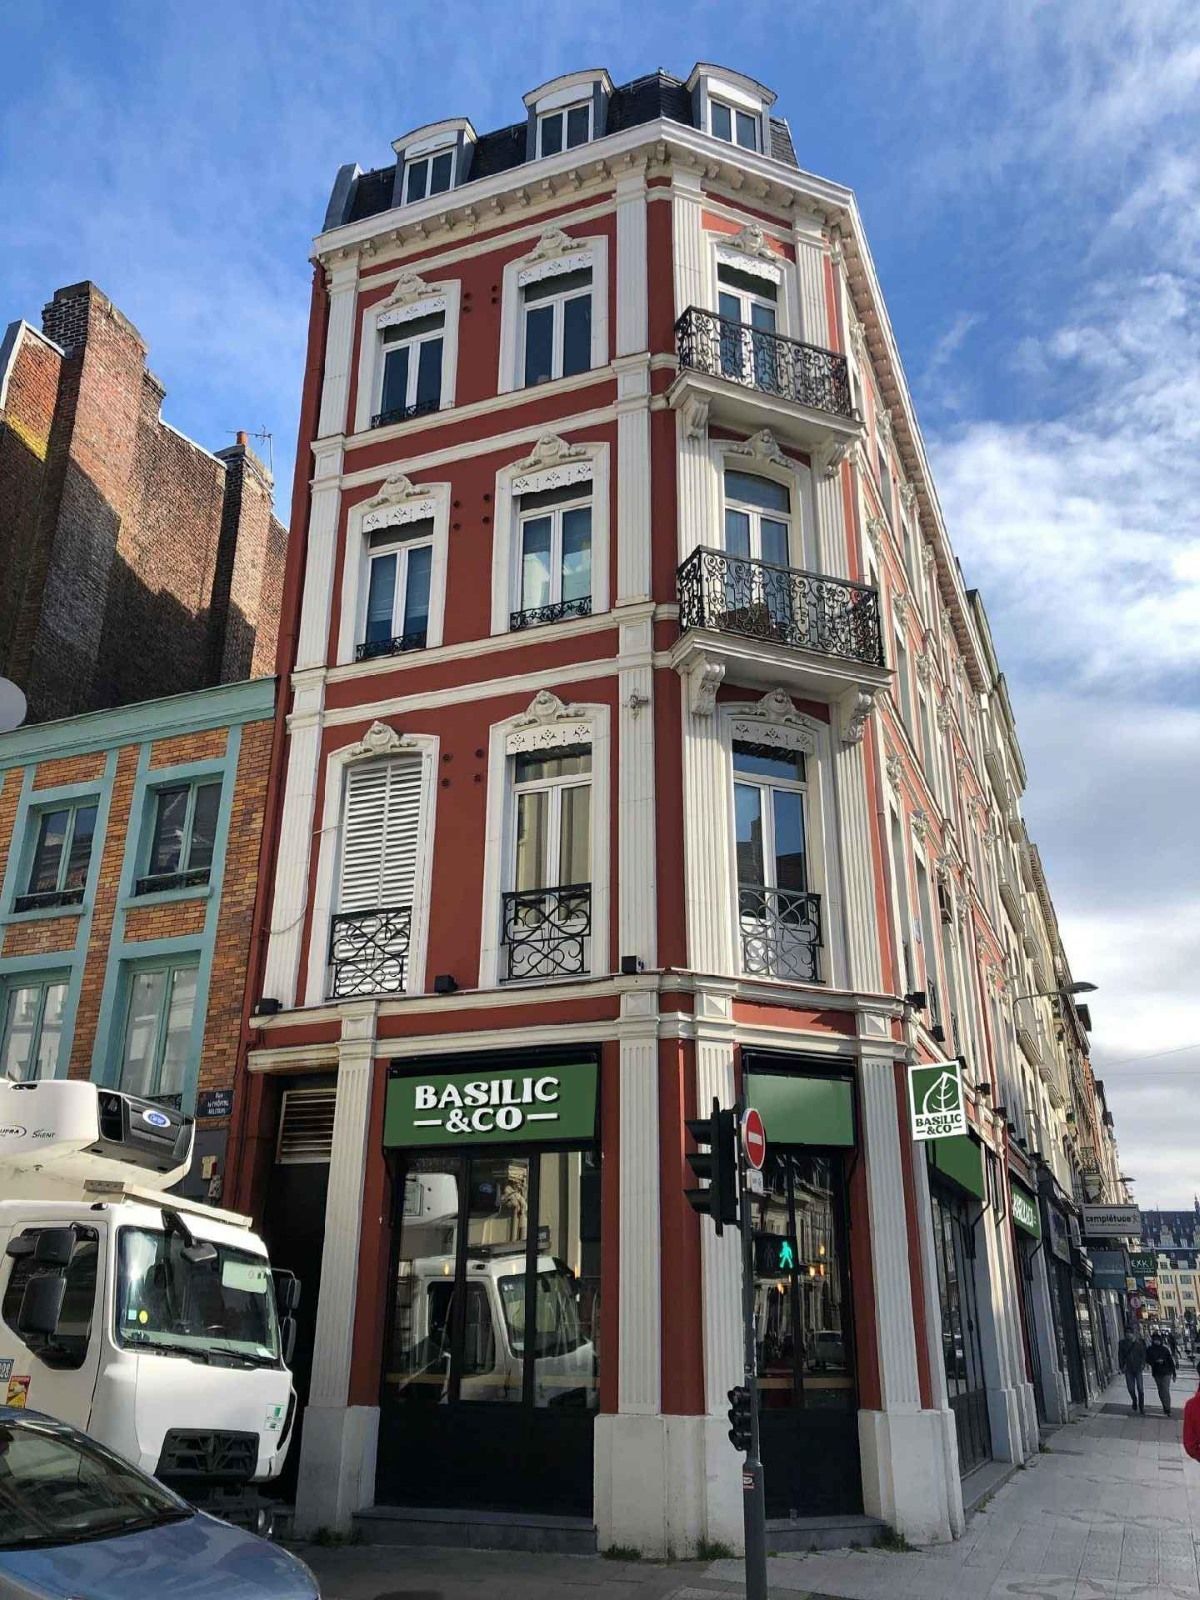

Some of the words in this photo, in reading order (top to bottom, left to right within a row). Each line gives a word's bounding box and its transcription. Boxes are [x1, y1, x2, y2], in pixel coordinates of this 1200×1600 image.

[415, 1077, 559, 1109] BASILIC
[446, 1106, 522, 1133] &CO
[915, 1114, 962, 1127] BASILIC
